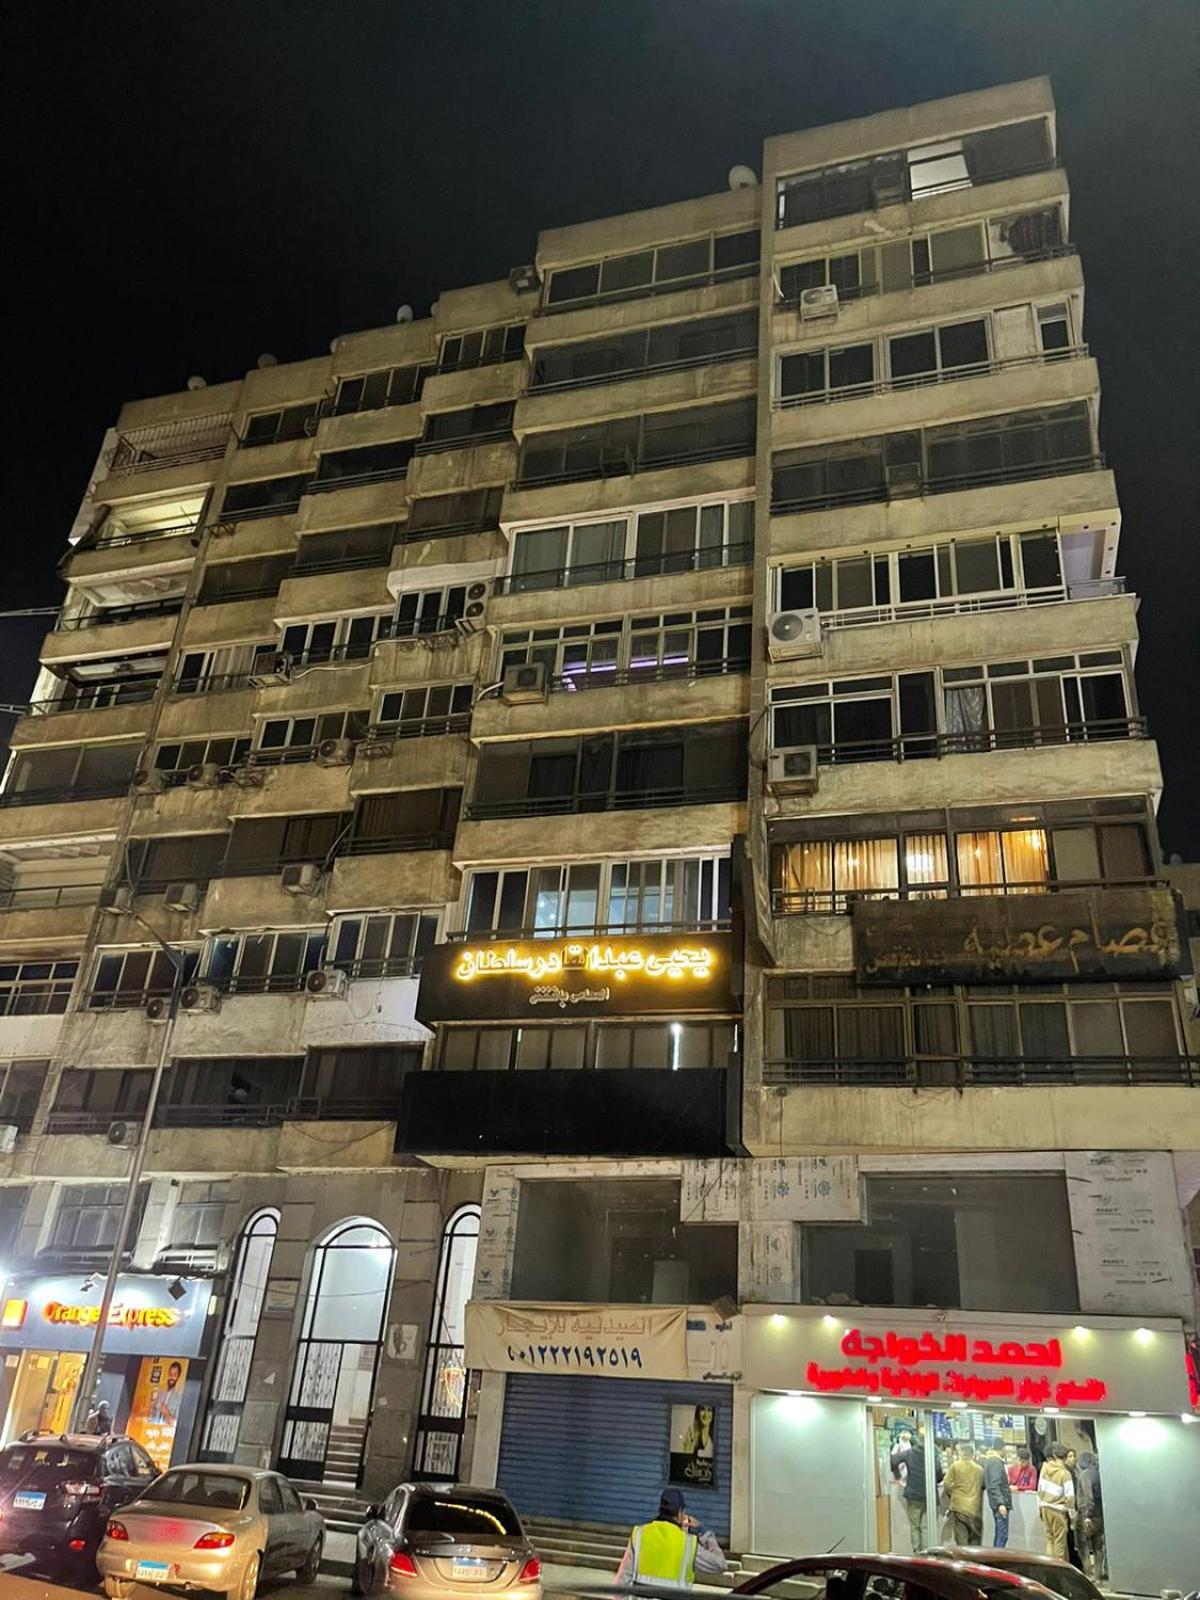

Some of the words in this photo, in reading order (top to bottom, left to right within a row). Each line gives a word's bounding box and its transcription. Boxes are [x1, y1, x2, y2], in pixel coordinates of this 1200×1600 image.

[1069, 902, 1180, 975] عصام
[456, 948, 530, 980] سلطان
[646, 946, 711, 978] يحيى
[43, 1301, 101, 1327] Orange
[107, 1303, 181, 1329] Express
[571, 1312, 653, 1341] الصيدلية
[1016, 1375, 1053, 1403] غيار
